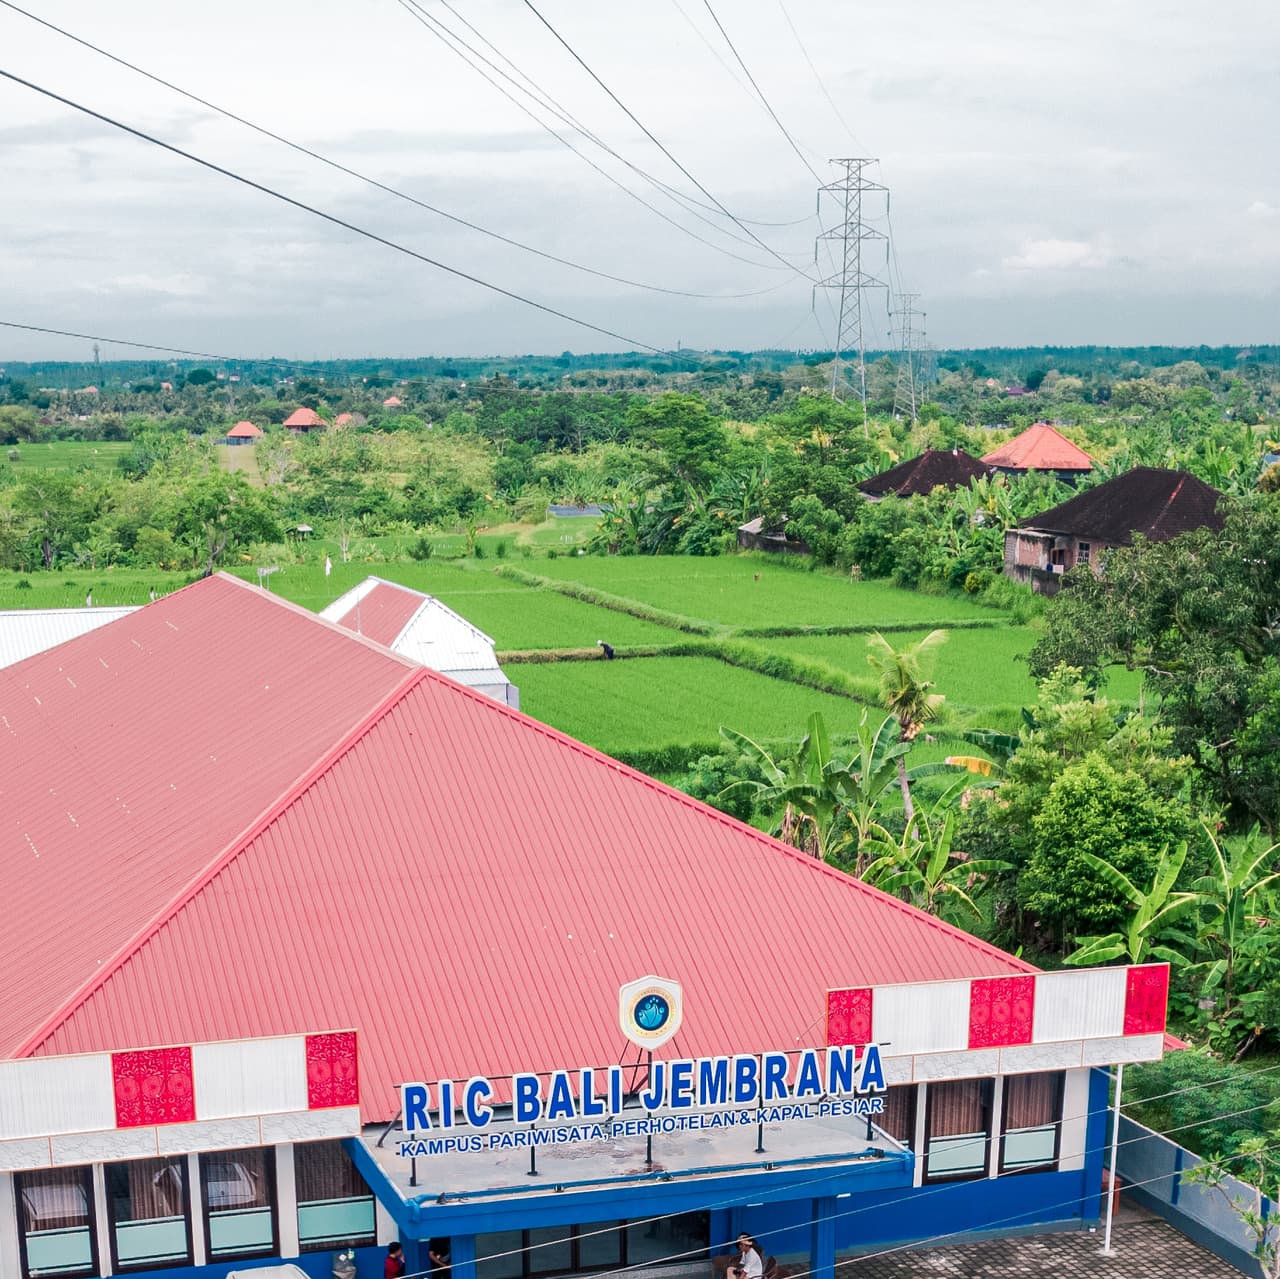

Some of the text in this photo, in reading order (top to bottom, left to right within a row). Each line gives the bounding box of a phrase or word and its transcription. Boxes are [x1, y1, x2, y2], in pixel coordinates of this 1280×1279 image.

[403, 1043, 886, 1133] RIC BALI JEMBRANA
[401, 1097, 884, 1158] KAMPUS PARIWISATA, PERHOTELAN & KAPAL PESIAR
